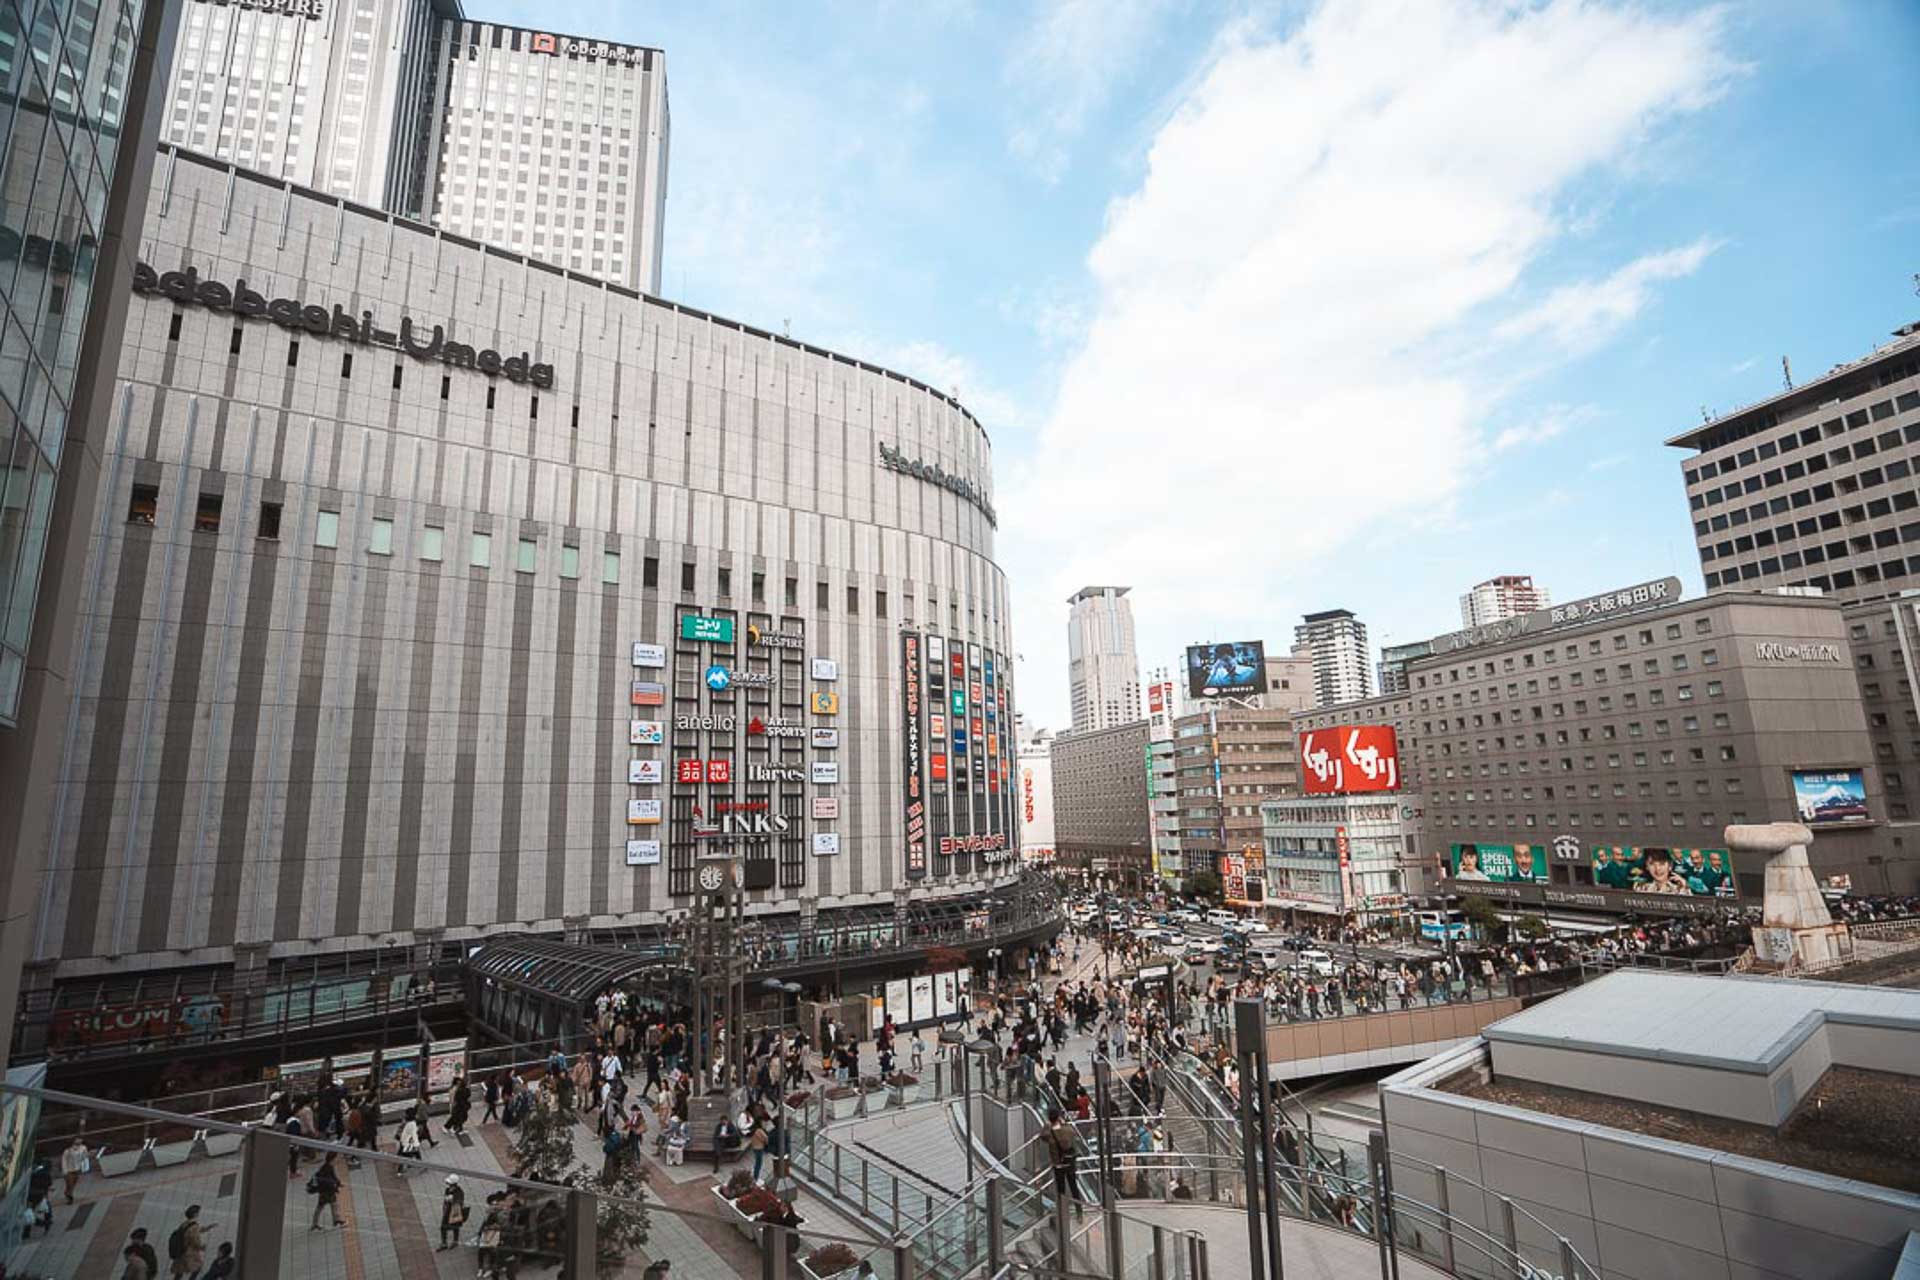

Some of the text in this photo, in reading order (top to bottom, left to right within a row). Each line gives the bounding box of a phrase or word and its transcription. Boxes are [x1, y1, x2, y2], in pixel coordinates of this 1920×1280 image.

[1551, 582, 1668, 623] 阪急 大阪梅田駅
[695, 619, 721, 631] ニトリ
[677, 714, 735, 732] anello
[768, 717, 787, 726] ART
[767, 727, 806, 737] SPORTS
[1303, 733, 1343, 790] くすり
[1346, 729, 1397, 787] くすり
